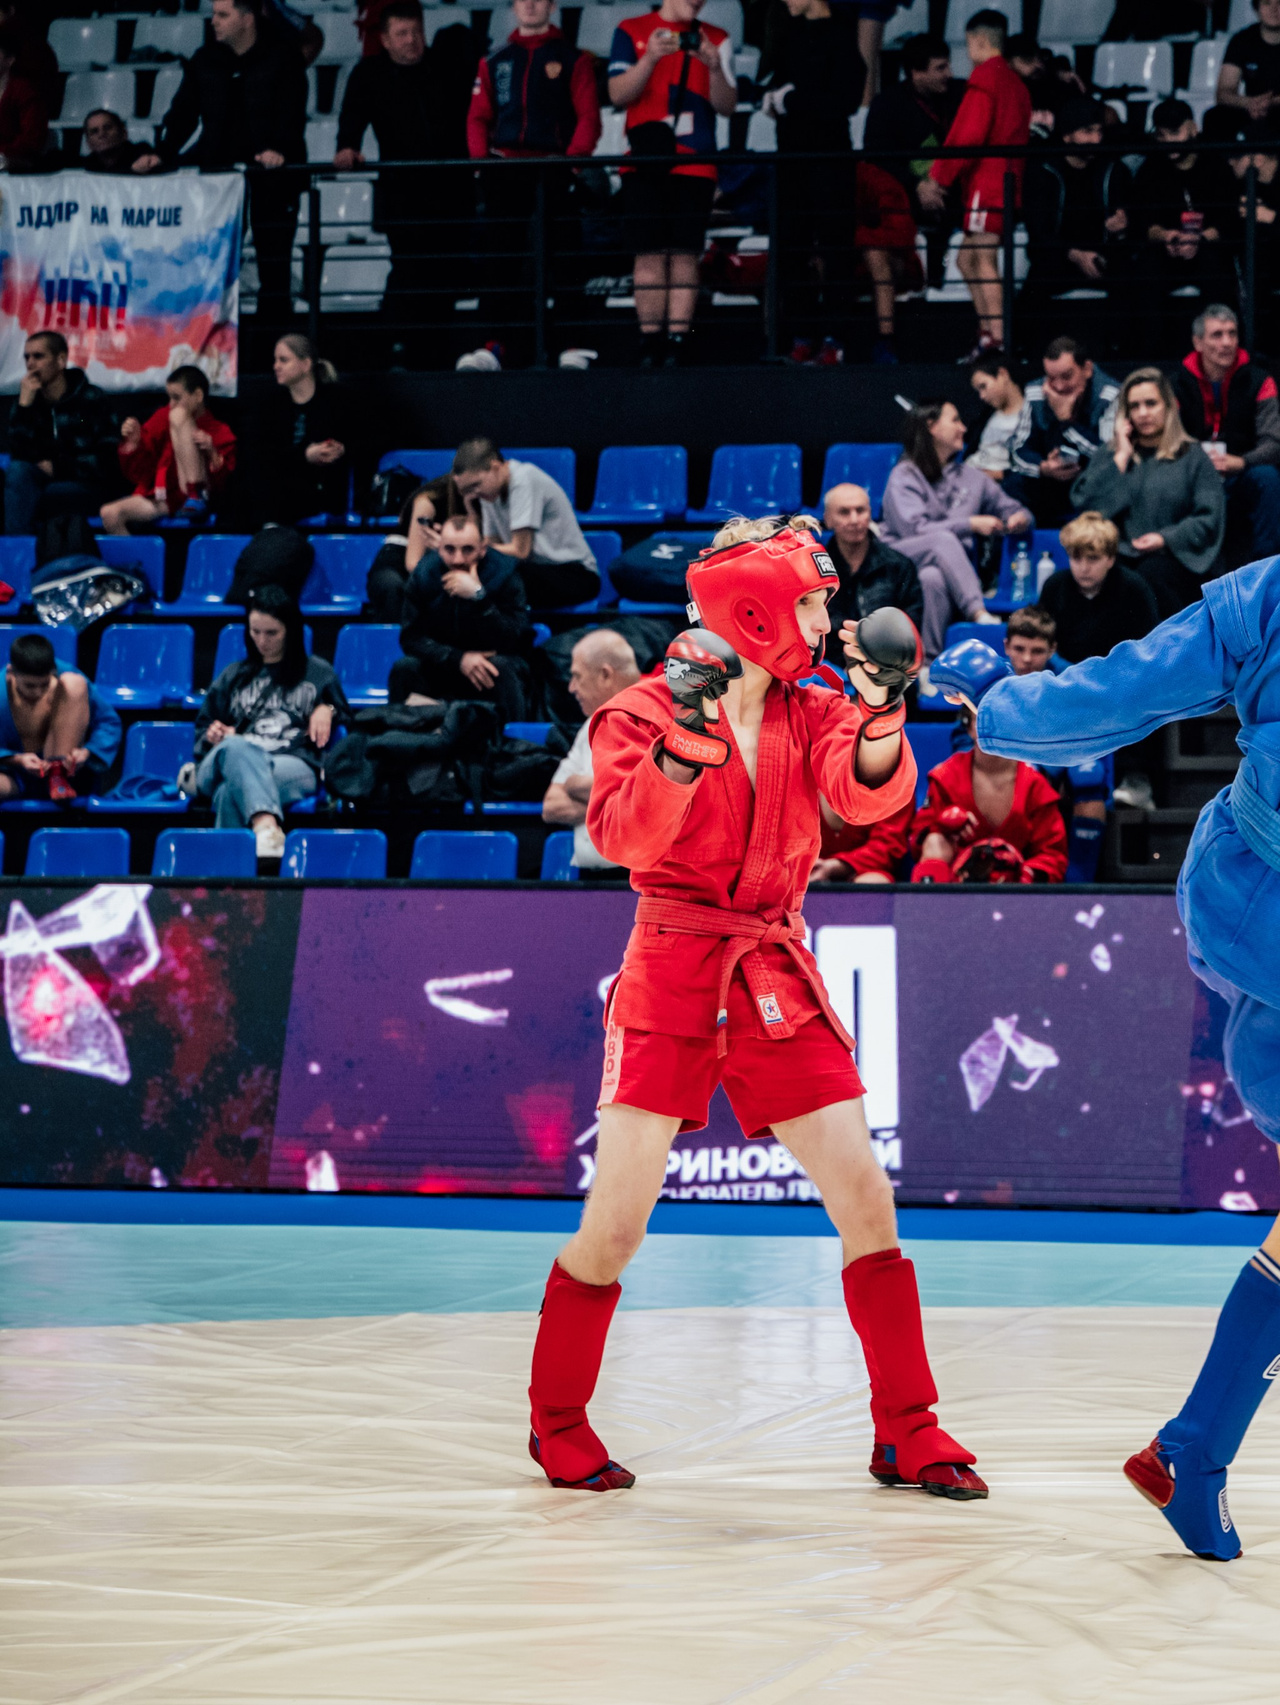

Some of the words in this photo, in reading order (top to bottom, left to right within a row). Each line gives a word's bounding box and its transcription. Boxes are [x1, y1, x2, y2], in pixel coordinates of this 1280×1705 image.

[91, 206, 108, 225] НА
[122, 206, 182, 227] МАРШЕ
[671, 740, 717, 760] ENERGY
[674, 733, 718, 755] PANTHER
[606, 1014, 618, 1074] MBO
[659, 1181, 785, 1200] СНОВАТЕЛЬ
